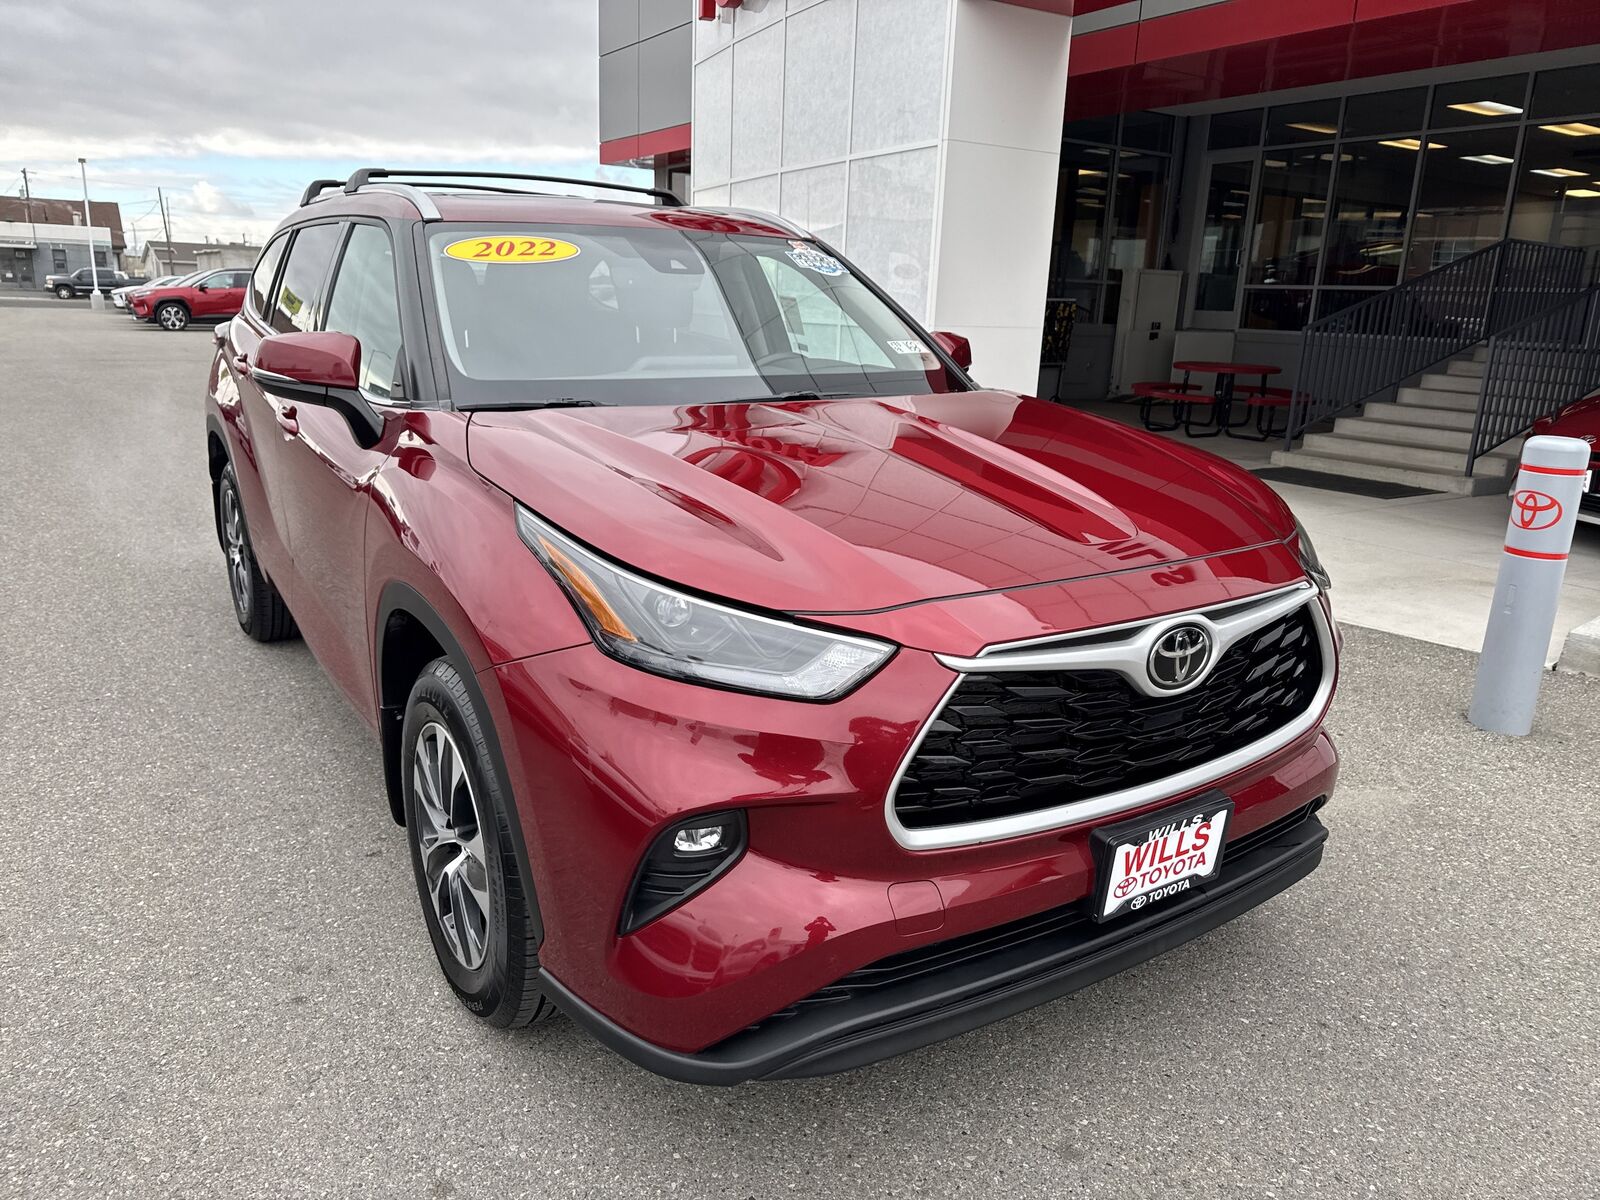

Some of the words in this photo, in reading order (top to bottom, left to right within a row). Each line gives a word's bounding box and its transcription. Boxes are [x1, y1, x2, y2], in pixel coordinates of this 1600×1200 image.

[473, 240, 557, 258] 2022
[1148, 813, 1204, 841] WILLS
[1124, 822, 1212, 876] WILLS
[1140, 851, 1206, 888] TOYOTA
[1148, 879, 1191, 902] TOYOTA
